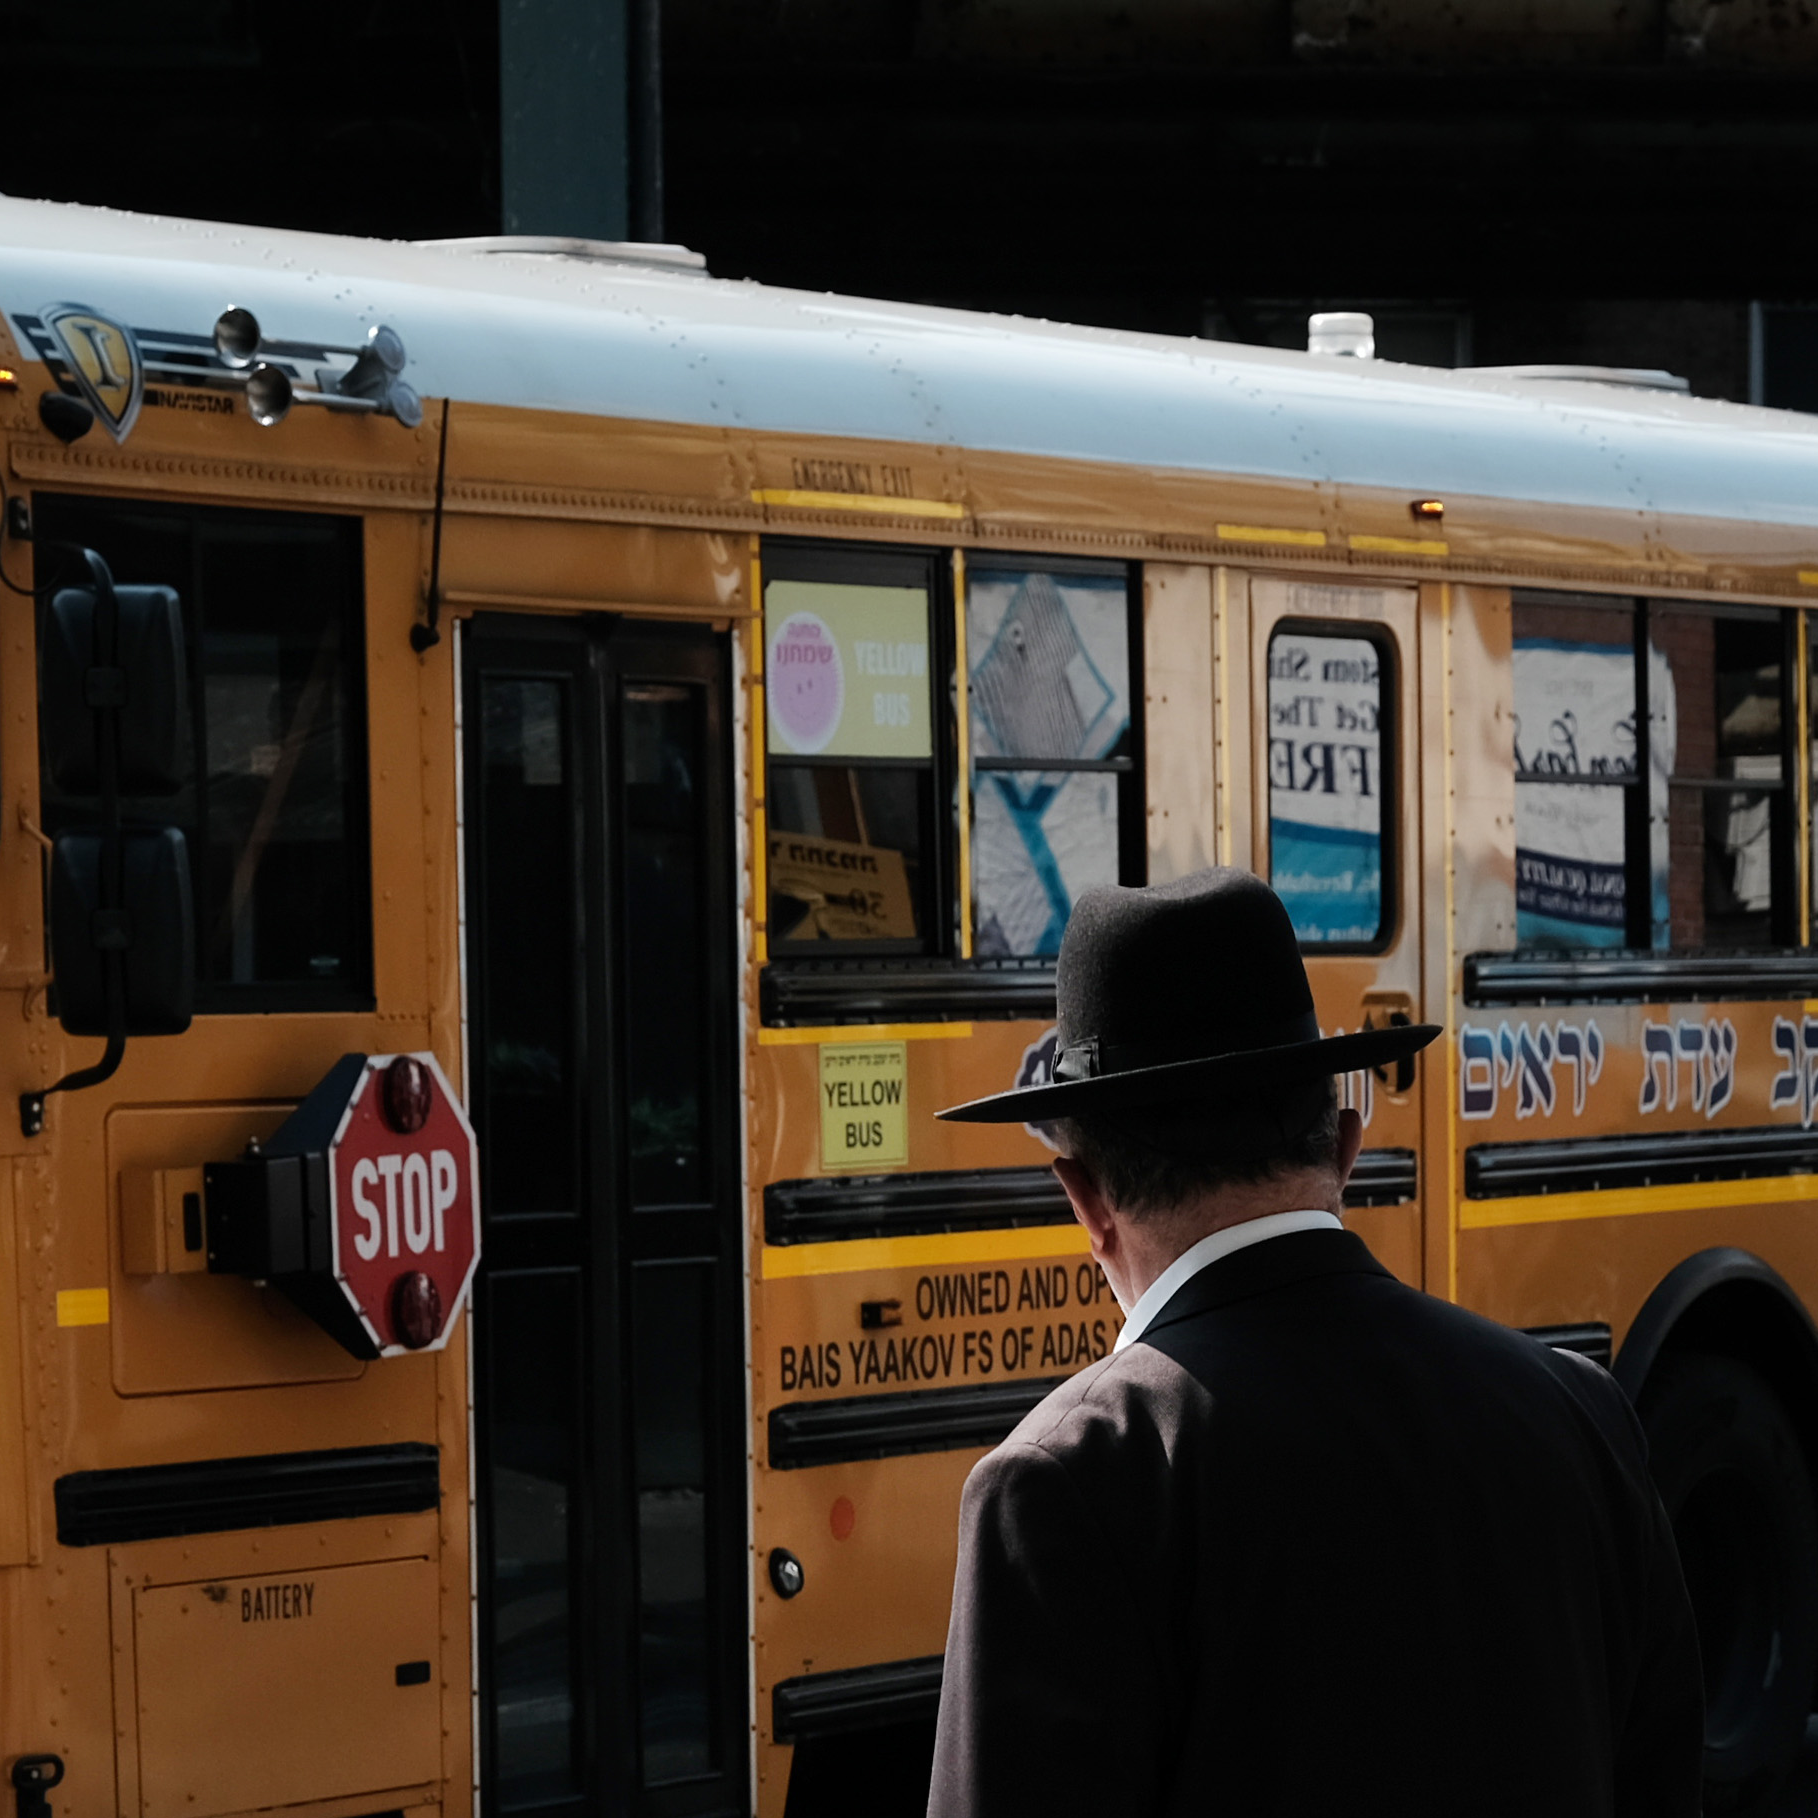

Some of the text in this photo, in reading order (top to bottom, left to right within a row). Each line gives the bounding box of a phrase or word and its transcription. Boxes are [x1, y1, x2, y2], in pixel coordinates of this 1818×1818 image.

[161, 390, 234, 414] NAVISTAR
[882, 464, 912, 498] EXIT
[854, 641, 929, 676] YELLOW
[873, 693, 911, 726] BUS
[1460, 1020, 1603, 1120] יראים
[1638, 1018, 1737, 1120] עדת
[824, 1079, 902, 1108] YELLOW
[845, 1121, 883, 1149] BUS
[352, 1149, 458, 1261] STOP
[916, 1271, 1010, 1320] OWNED
[1018, 1265, 1068, 1311] AND
[781, 1342, 841, 1390] BAIS
[849, 1333, 955, 1384] YAAKOV
[963, 1330, 995, 1375] FS
[1002, 1327, 1034, 1372] OF
[1041, 1320, 1107, 1368] ADAS
[241, 1582, 315, 1622] BATTERY
